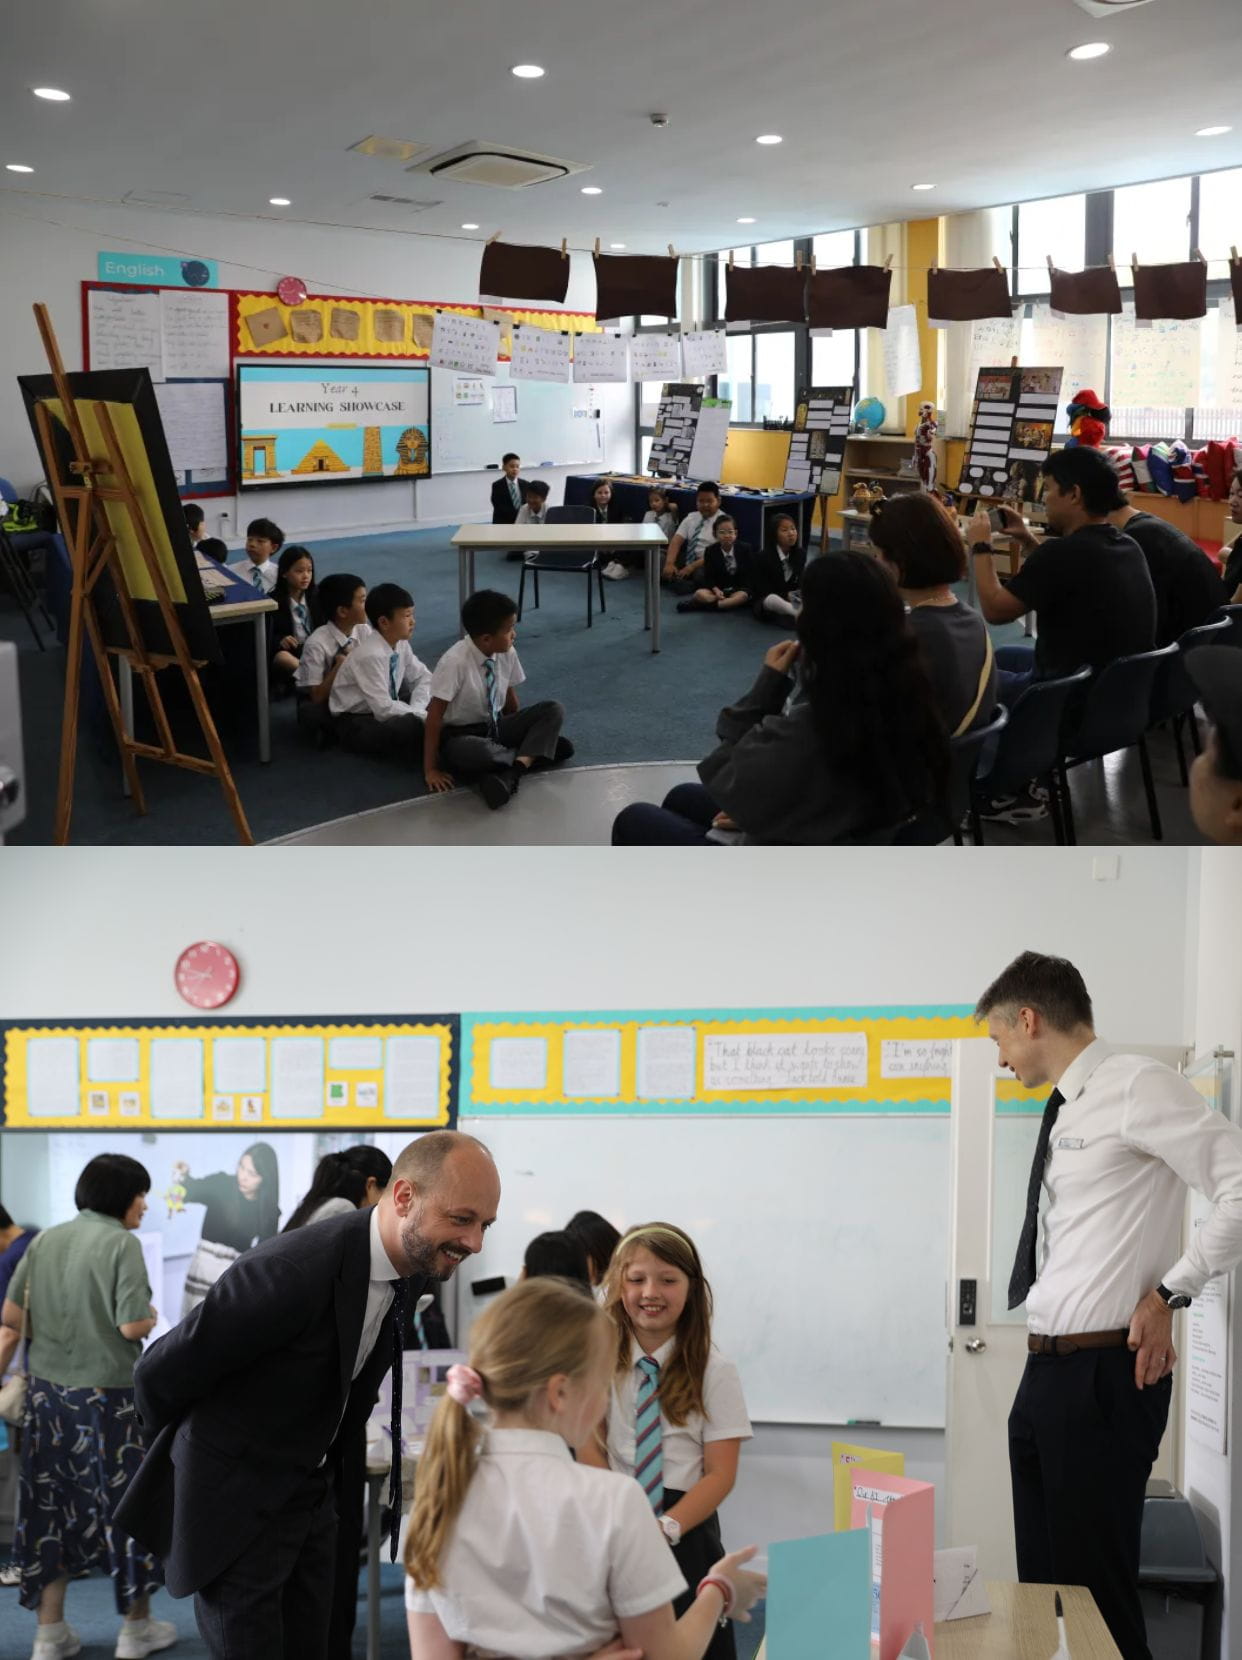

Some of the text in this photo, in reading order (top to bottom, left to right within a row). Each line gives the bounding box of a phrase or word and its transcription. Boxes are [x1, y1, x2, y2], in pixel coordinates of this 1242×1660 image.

[105, 261, 165, 278] English
[320, 382, 359, 398] Year 4
[269, 401, 406, 413] LEARNING SHOWCASE
